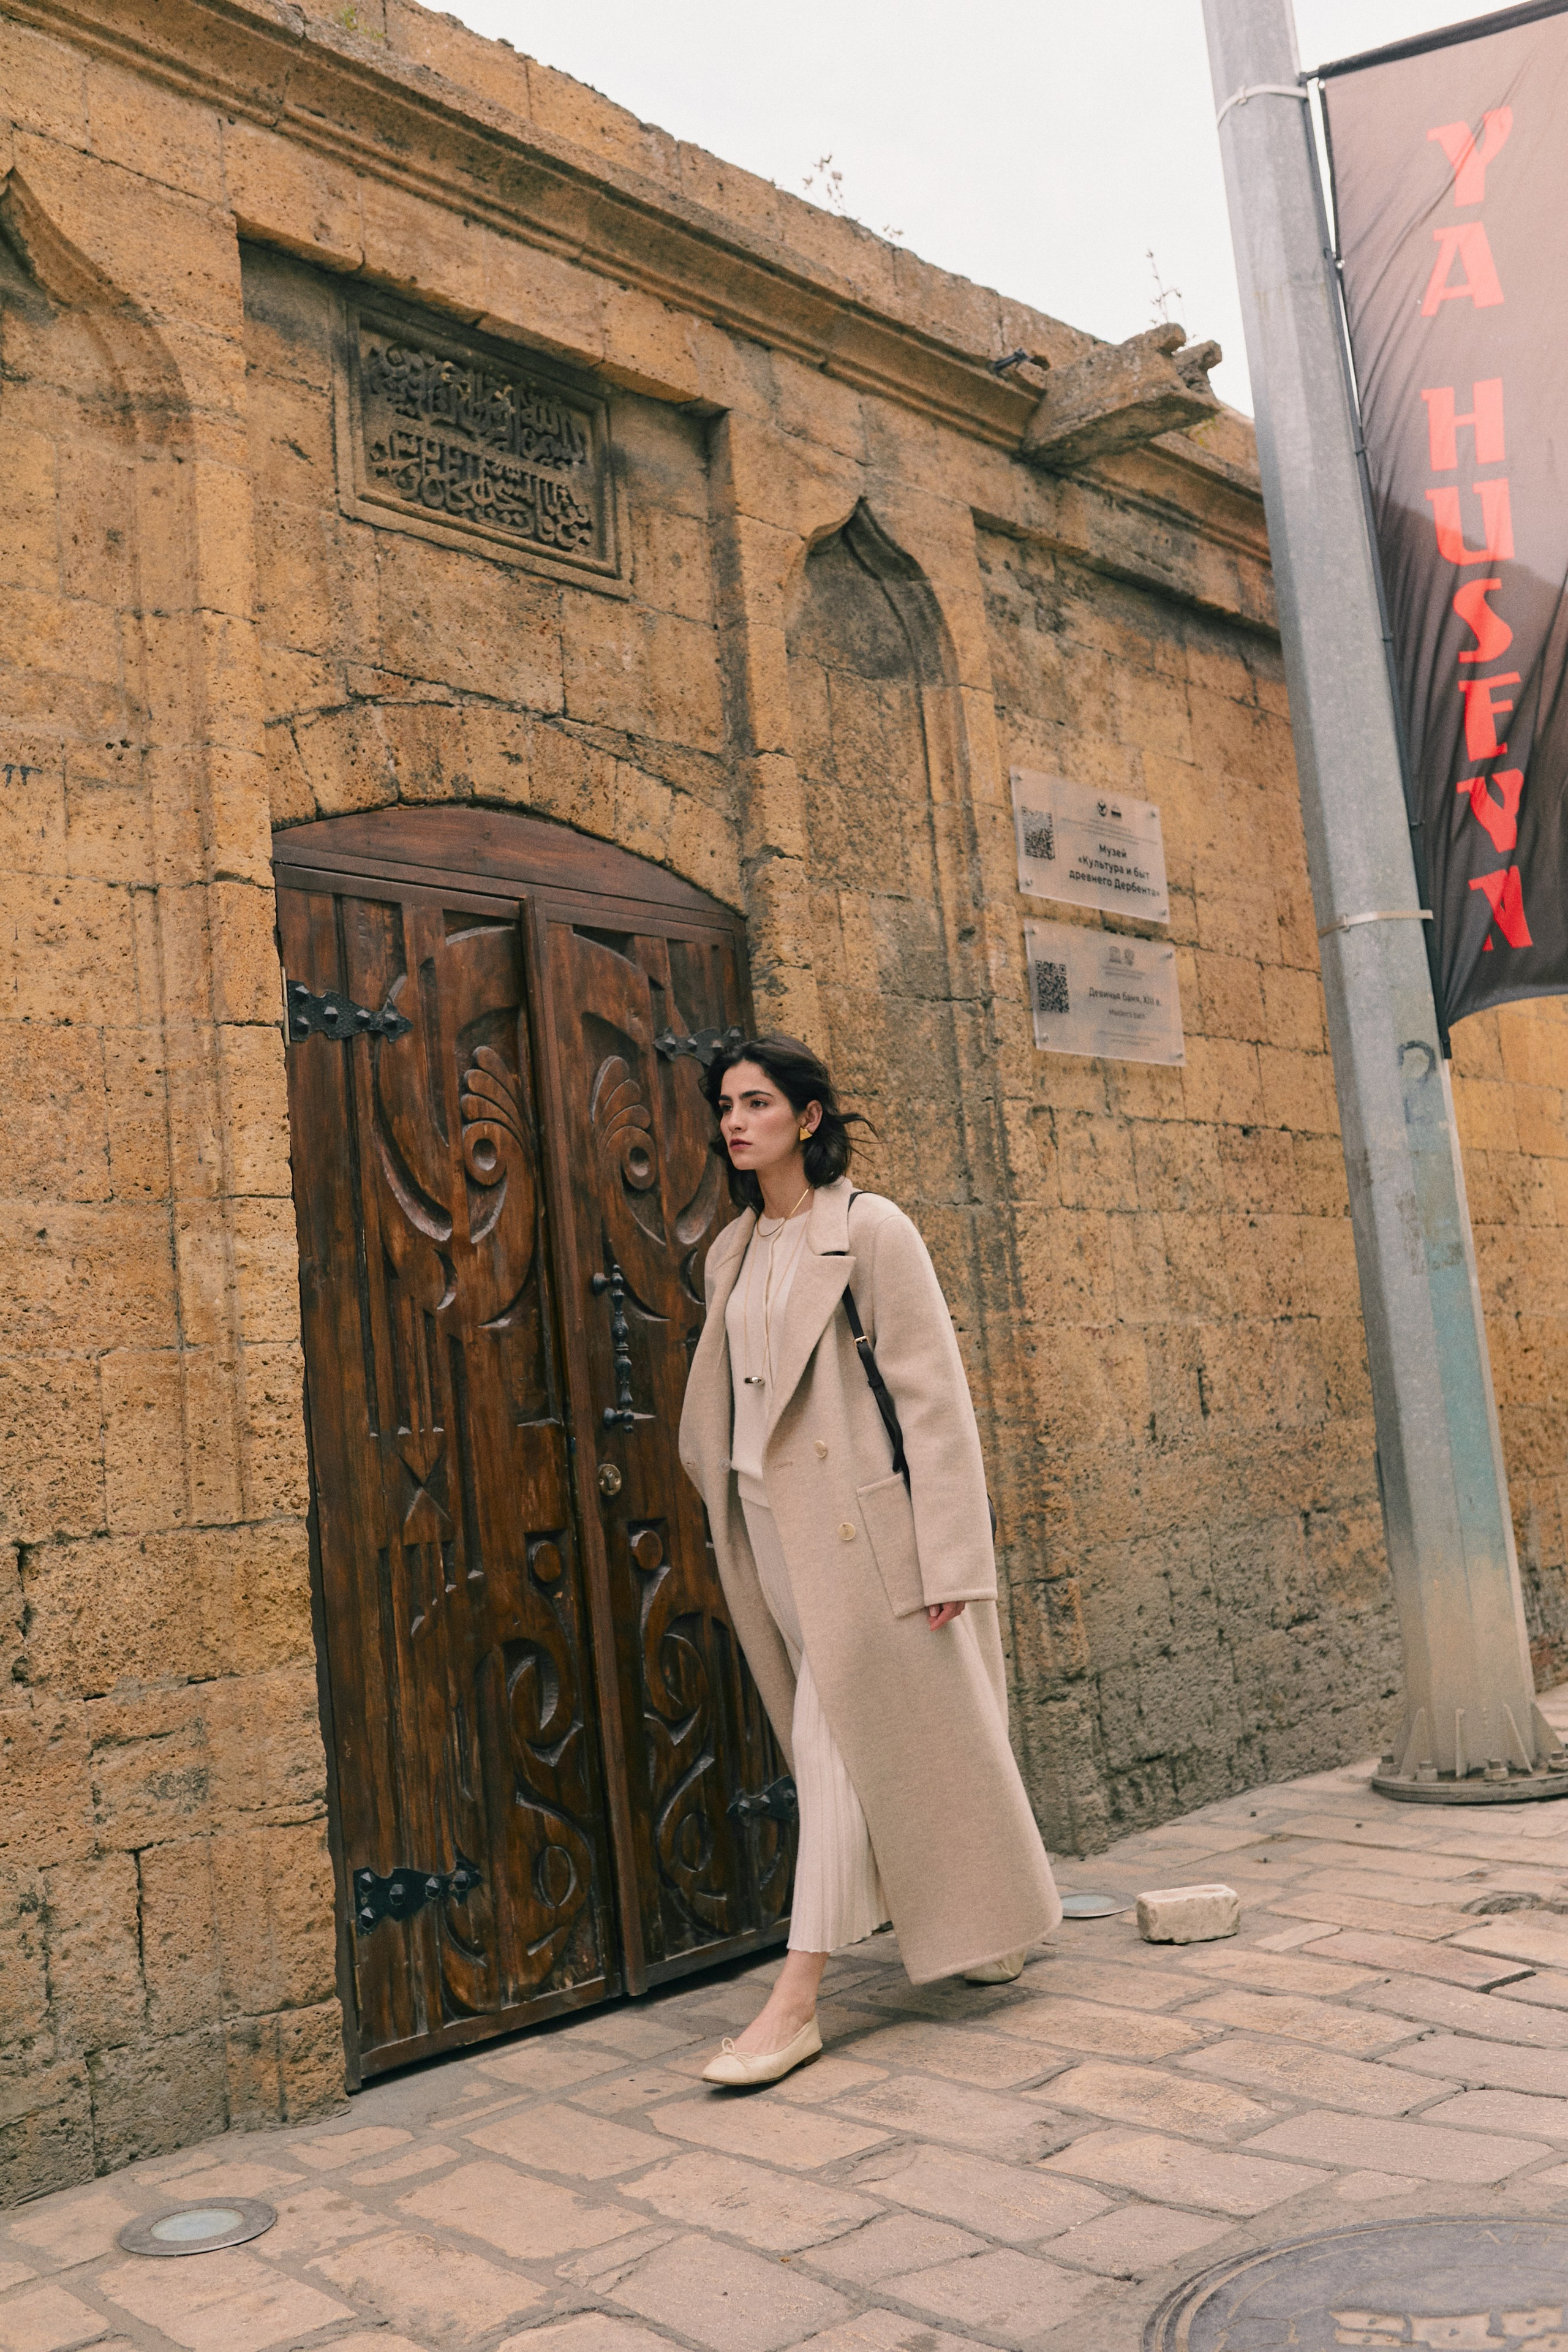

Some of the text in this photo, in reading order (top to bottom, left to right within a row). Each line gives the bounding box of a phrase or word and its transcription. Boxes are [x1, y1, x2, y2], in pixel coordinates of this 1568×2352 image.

[1421, 105, 1513, 317] YA
[1099, 843, 1126, 858] Музей
[1069, 870, 1112, 886] древнего
[1134, 867, 1150, 879] быт
